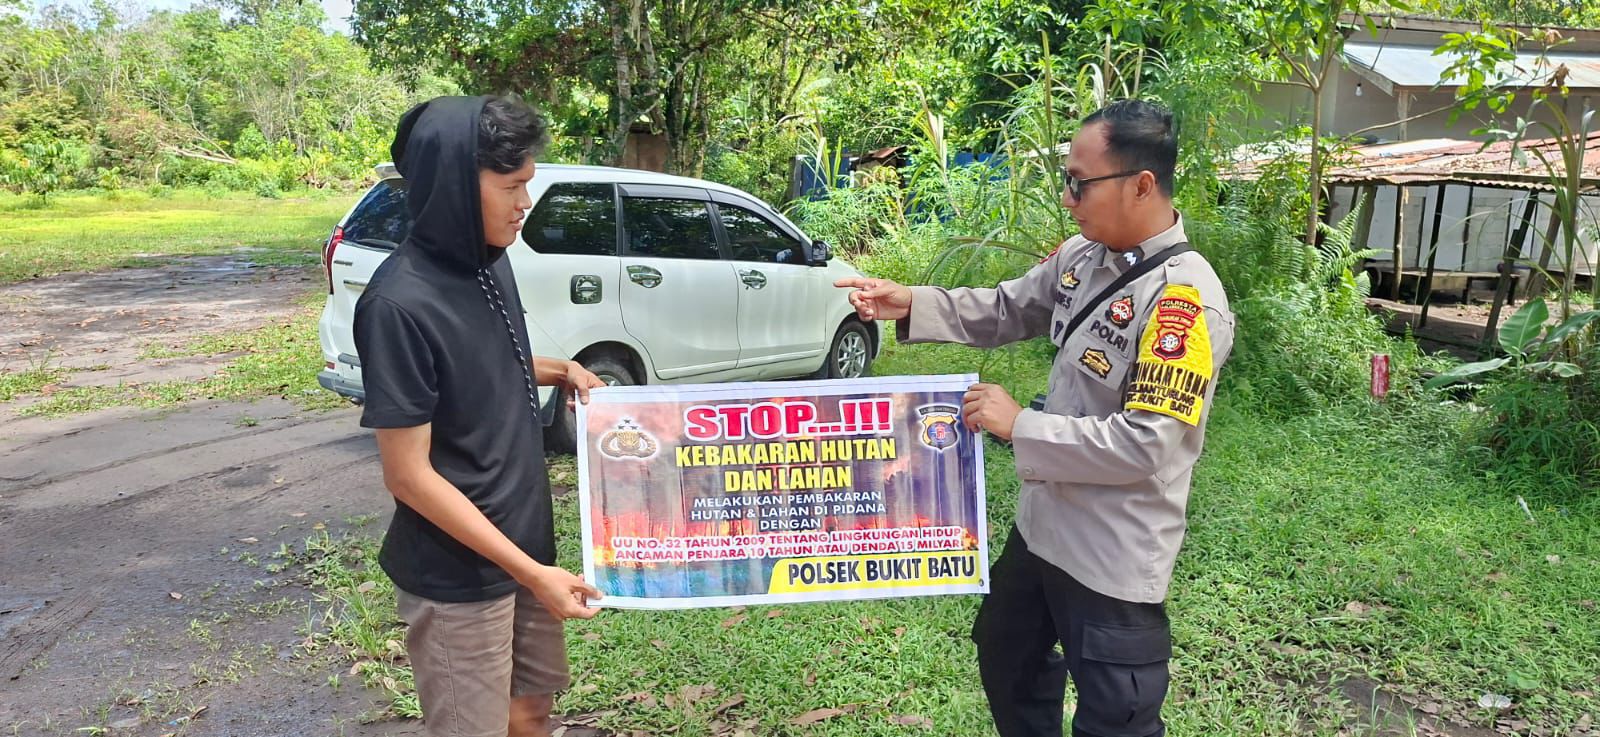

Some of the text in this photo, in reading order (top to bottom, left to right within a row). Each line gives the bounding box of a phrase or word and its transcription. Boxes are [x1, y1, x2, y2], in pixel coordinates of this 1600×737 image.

[1090, 319, 1129, 352] POLRI
[1169, 400, 1193, 417] BATU
[675, 438, 896, 467] KEBAKARAN HUTAN
[725, 465, 852, 492] DAN LAHAN
[694, 491, 882, 508] MELAKUKAN PEMBAKARAN
[691, 503, 887, 521] HUTAN & LAHAN DI PIDANA
[760, 518, 822, 530] DENGAN
[613, 527, 962, 549] UU NO. 32 TAHUN 2009 TENTANG LINGKUNGAN HIDUP
[615, 538, 961, 561] ANCAMAN PENJARA 10 TAHUN ATAU DENDA 15 MILYAR
[788, 555, 976, 585] POLSEK BUKIT BATU
